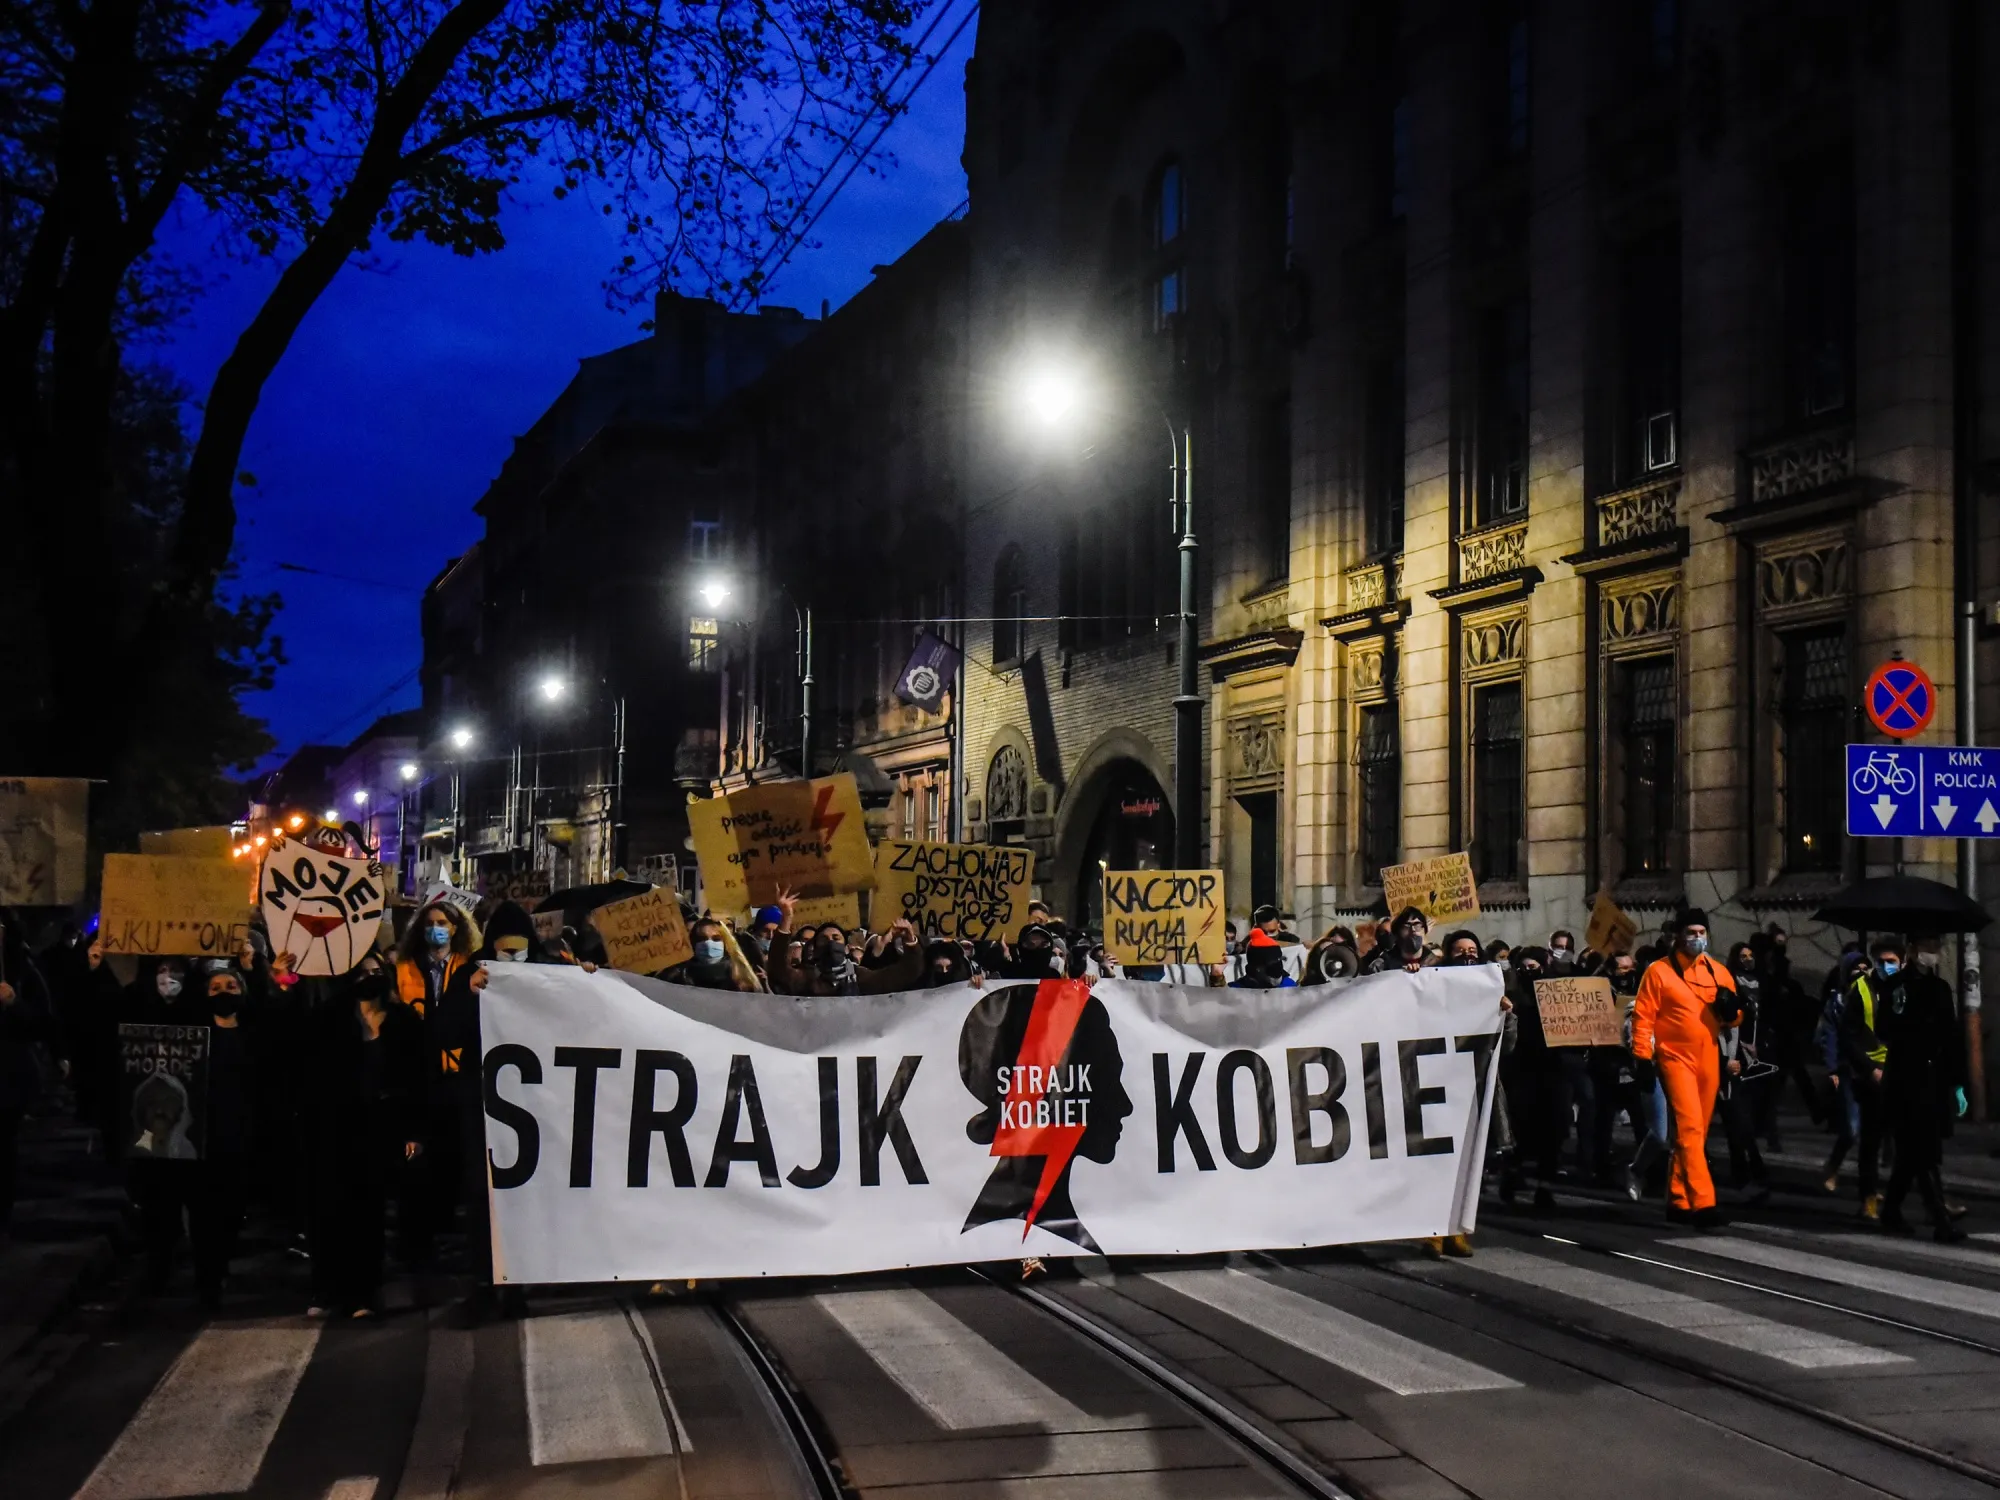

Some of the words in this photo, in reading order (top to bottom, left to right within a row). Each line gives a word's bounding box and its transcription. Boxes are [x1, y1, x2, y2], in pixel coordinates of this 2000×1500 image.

[1948, 752, 1983, 767] KMK
[1934, 773, 1997, 789] POLICJA
[890, 844, 1027, 885] ZACHOWAJ
[265, 857, 382, 923] MOJE!
[916, 875, 1009, 903] DYSTANS
[1106, 873, 1216, 914] KACZOR
[901, 892, 928, 909] OD
[952, 900, 1013, 924] MOJEJ
[902, 909, 996, 941] MACICY
[1115, 917, 1186, 946] RUCHA
[996, 1063, 1094, 1096] STRAJK
[483, 1043, 930, 1190] STRAJK
[1152, 1033, 1502, 1174] KOBIET
[1001, 1098, 1090, 1131] KOBIET
